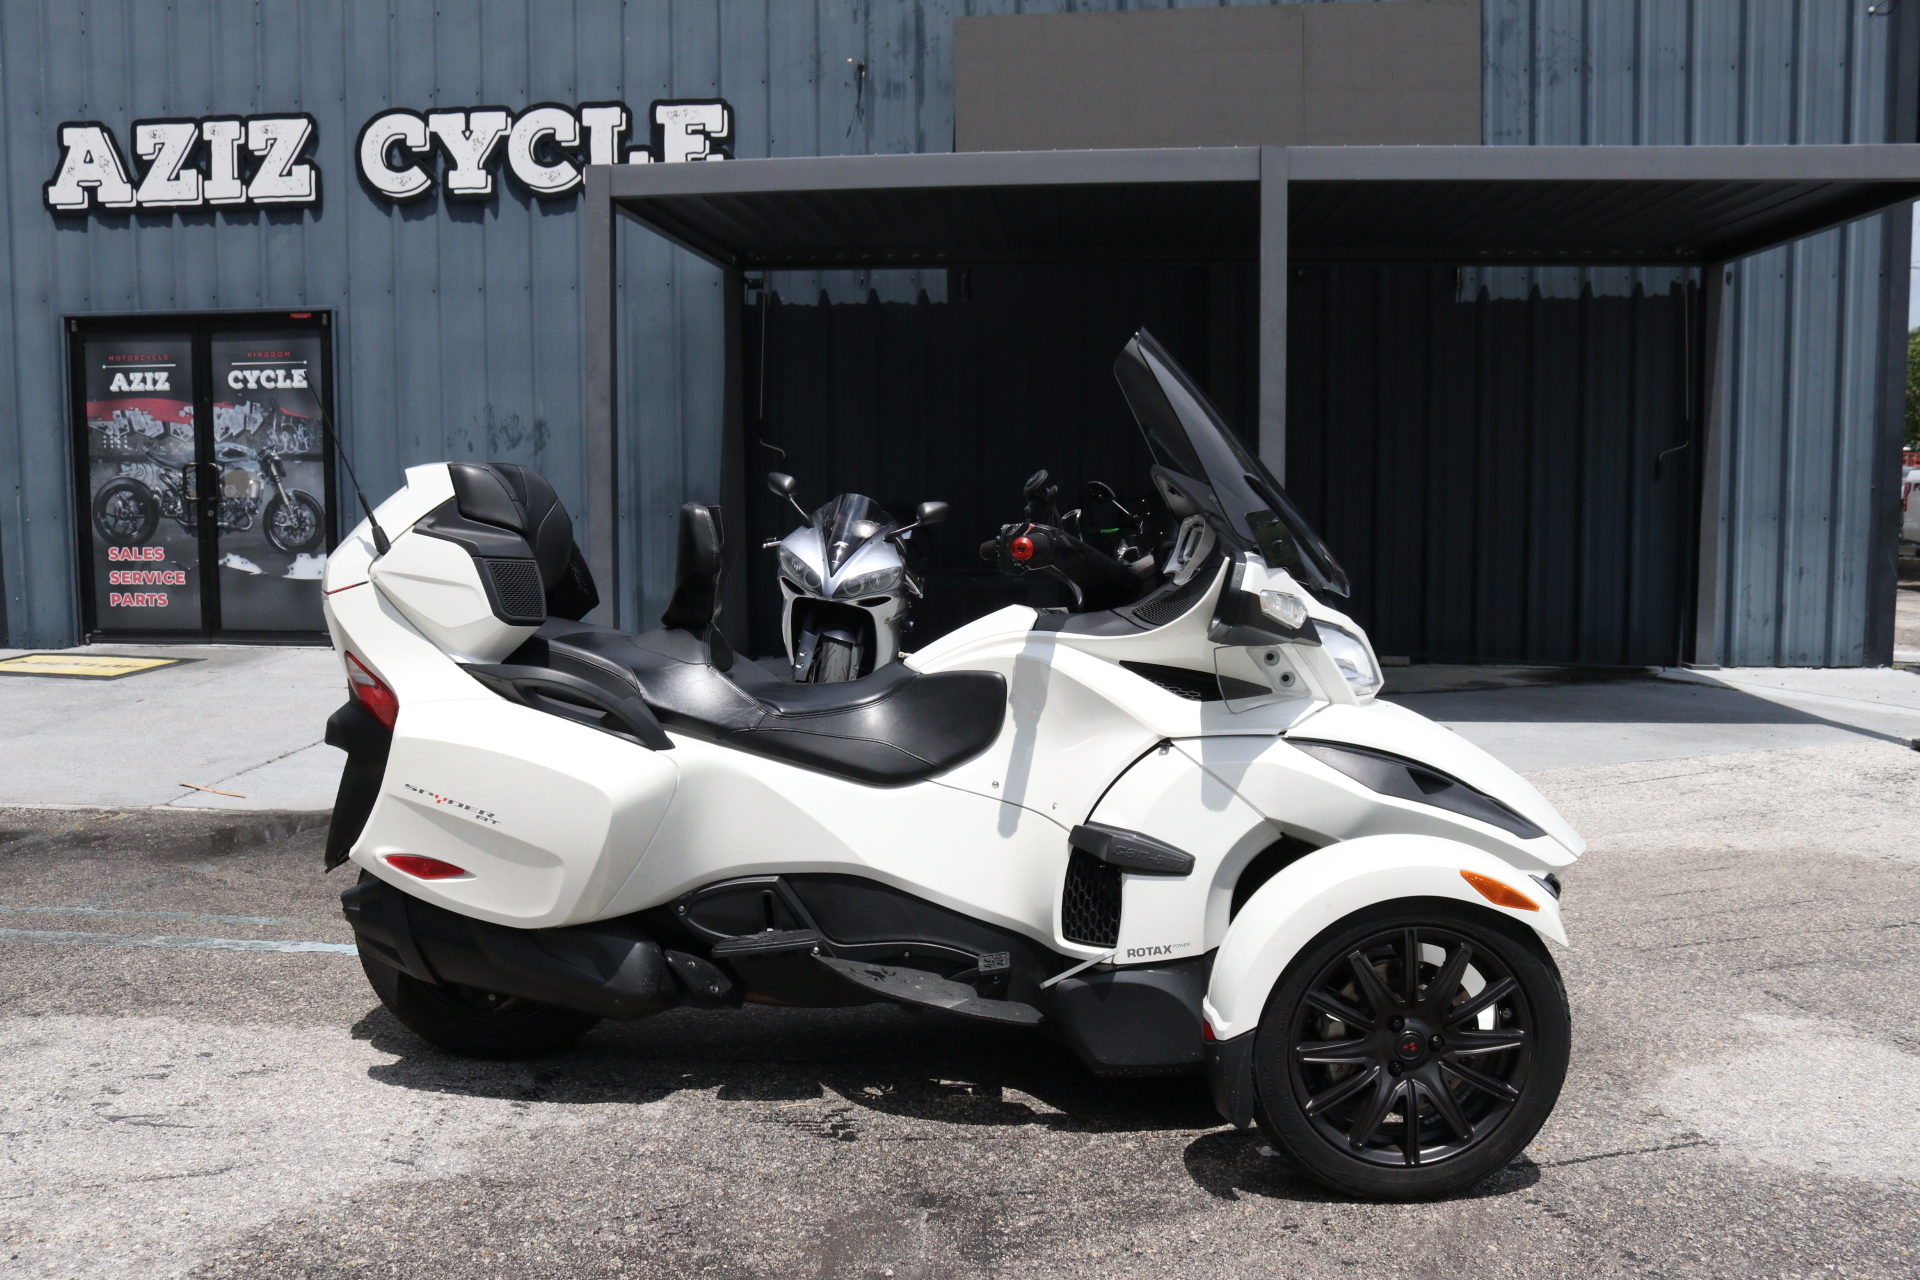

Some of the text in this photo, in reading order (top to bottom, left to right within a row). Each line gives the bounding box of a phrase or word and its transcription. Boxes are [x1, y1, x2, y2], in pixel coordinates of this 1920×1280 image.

[46, 101, 732, 211] AZIZ CYCLE
[110, 369, 308, 392] AZIZ CYCLE
[108, 547, 165, 561] SALES
[109, 570, 186, 585] SERVICE
[110, 593, 168, 607] PARTS
[1127, 945, 1172, 958] ROTAX
